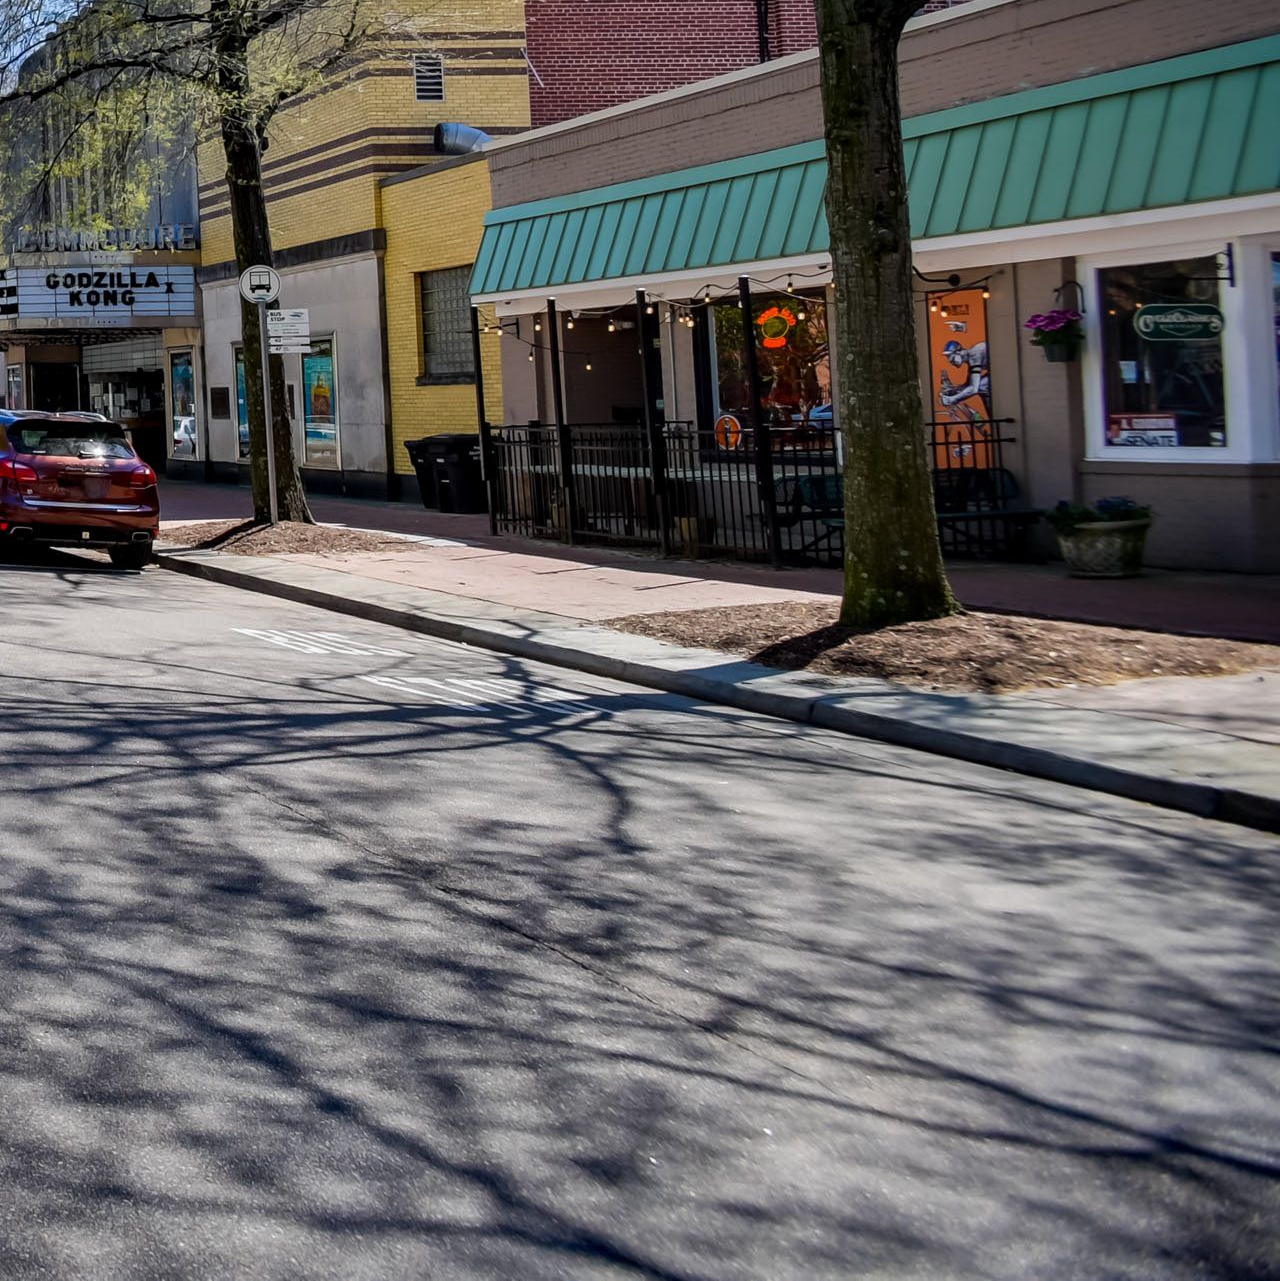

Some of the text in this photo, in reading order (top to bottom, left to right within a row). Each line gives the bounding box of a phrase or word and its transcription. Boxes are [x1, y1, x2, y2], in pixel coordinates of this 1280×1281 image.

[45, 271, 160, 290] GODZILLA
[69, 290, 136, 307] KONG
[230, 627, 416, 658] BUS
